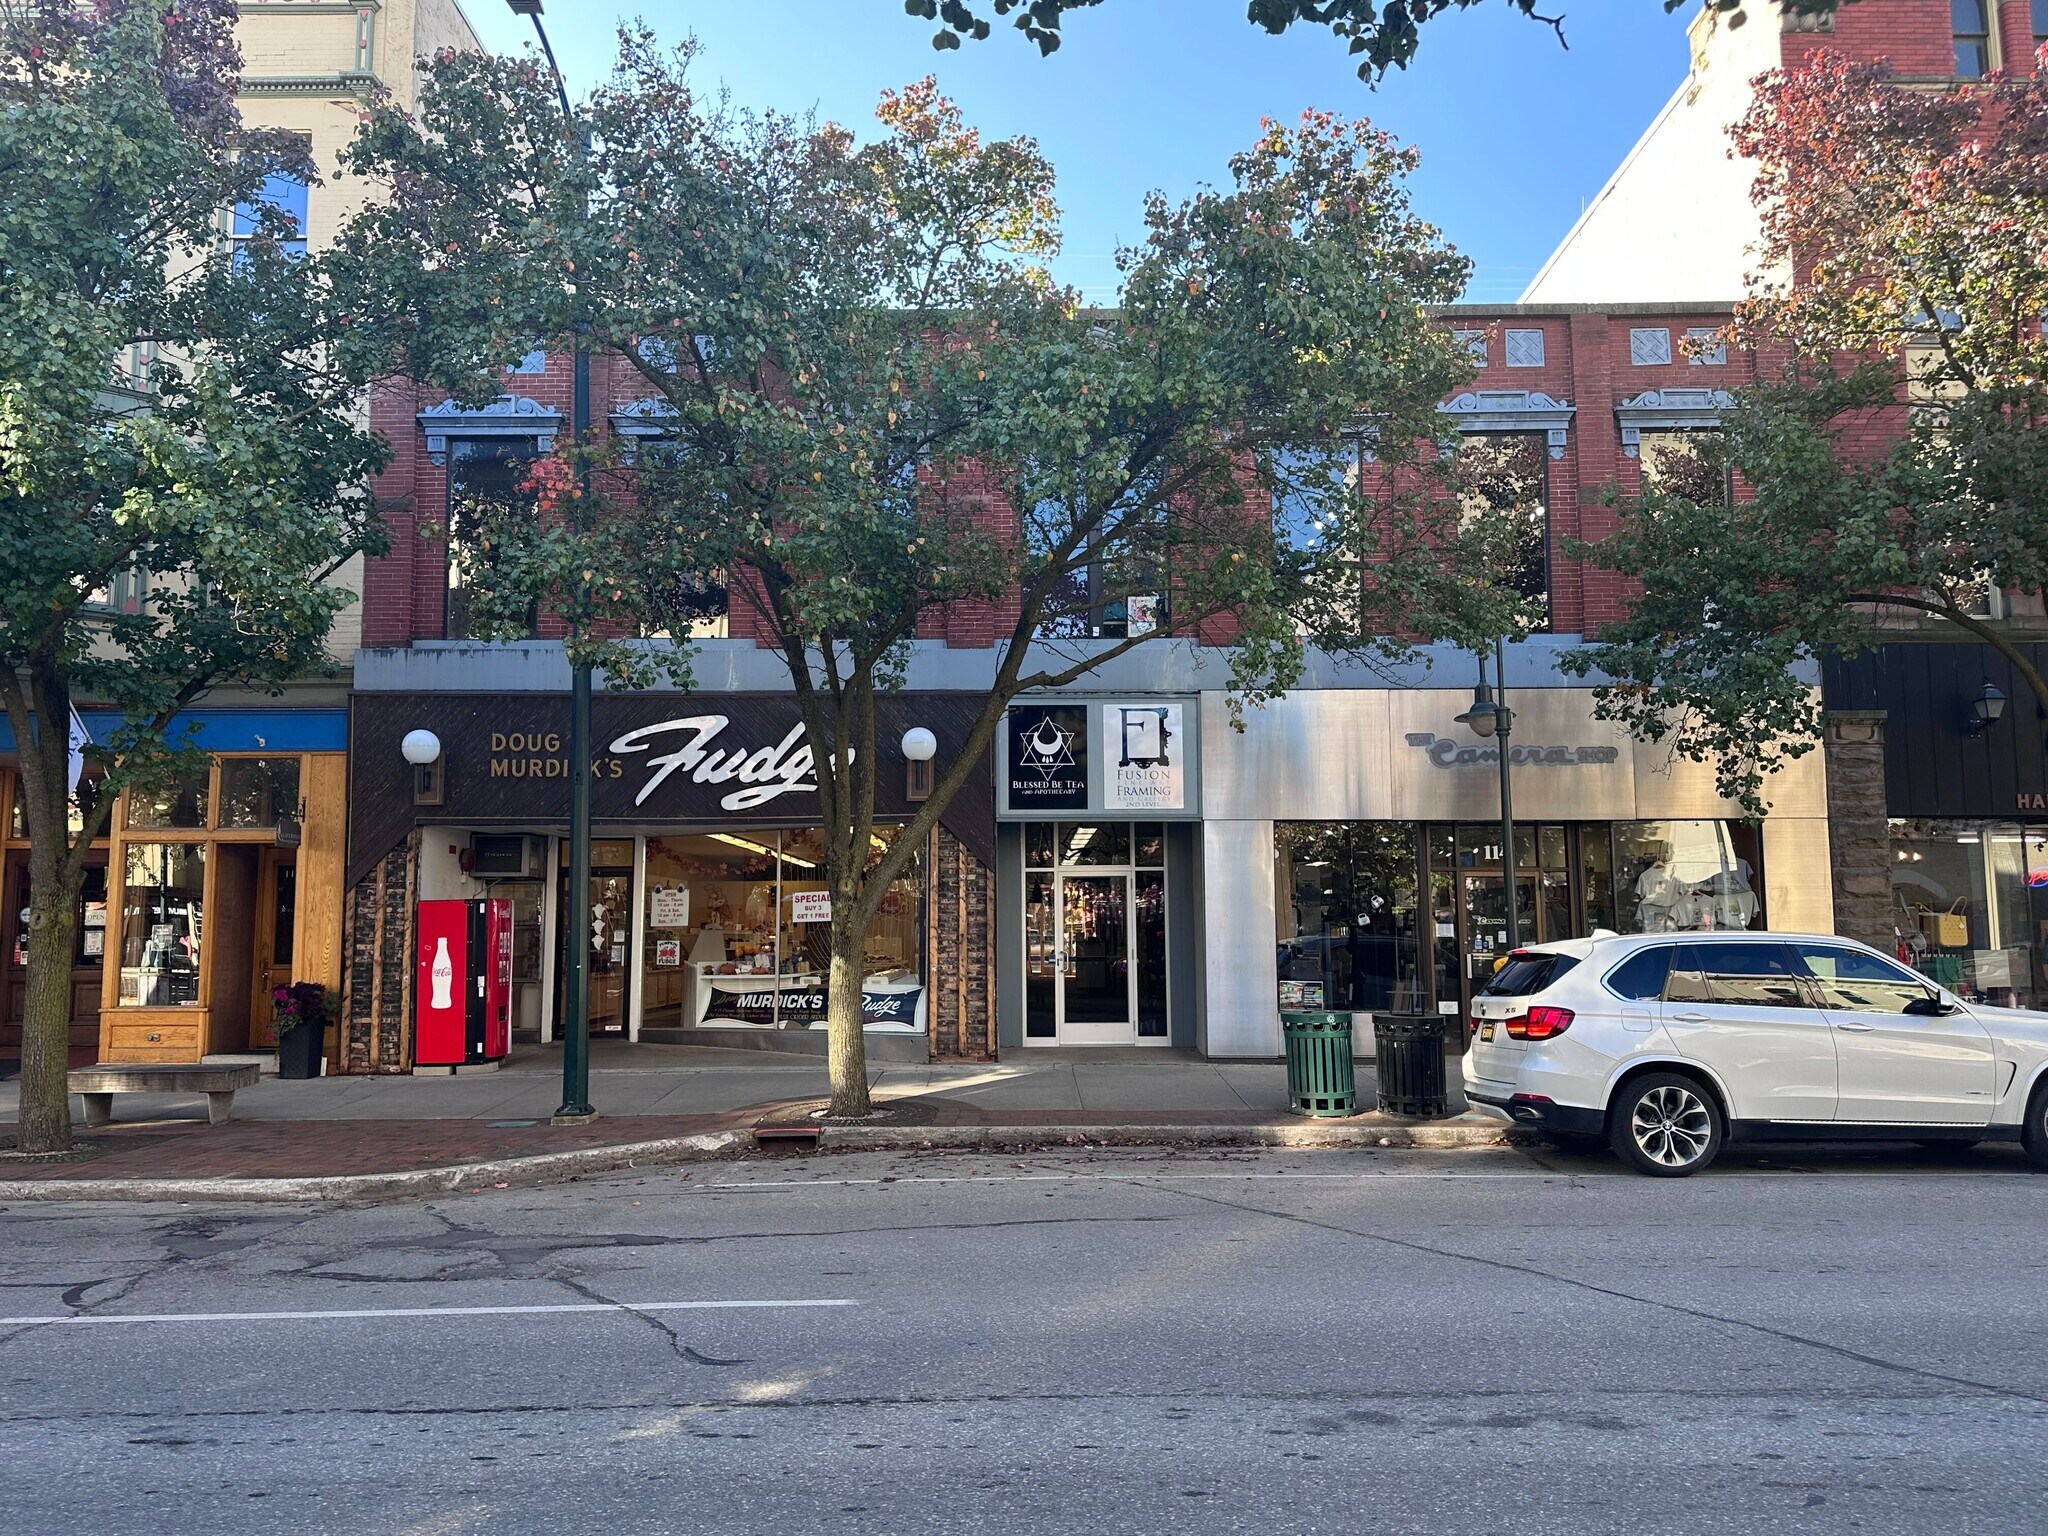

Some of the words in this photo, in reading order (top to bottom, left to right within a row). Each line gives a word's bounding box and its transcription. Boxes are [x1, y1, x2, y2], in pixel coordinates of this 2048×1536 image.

[491, 733, 560, 753] DOUG
[1577, 747, 1618, 762] SHOP
[490, 758, 623, 779] MURDIK'S
[1117, 769, 1170, 780] FUSION
[1013, 780, 1050, 789] BLESSED
[1117, 785, 1171, 796] FRAMING
[2017, 794, 2048, 809] HA
[736, 994, 824, 1009] MURDICK'S
